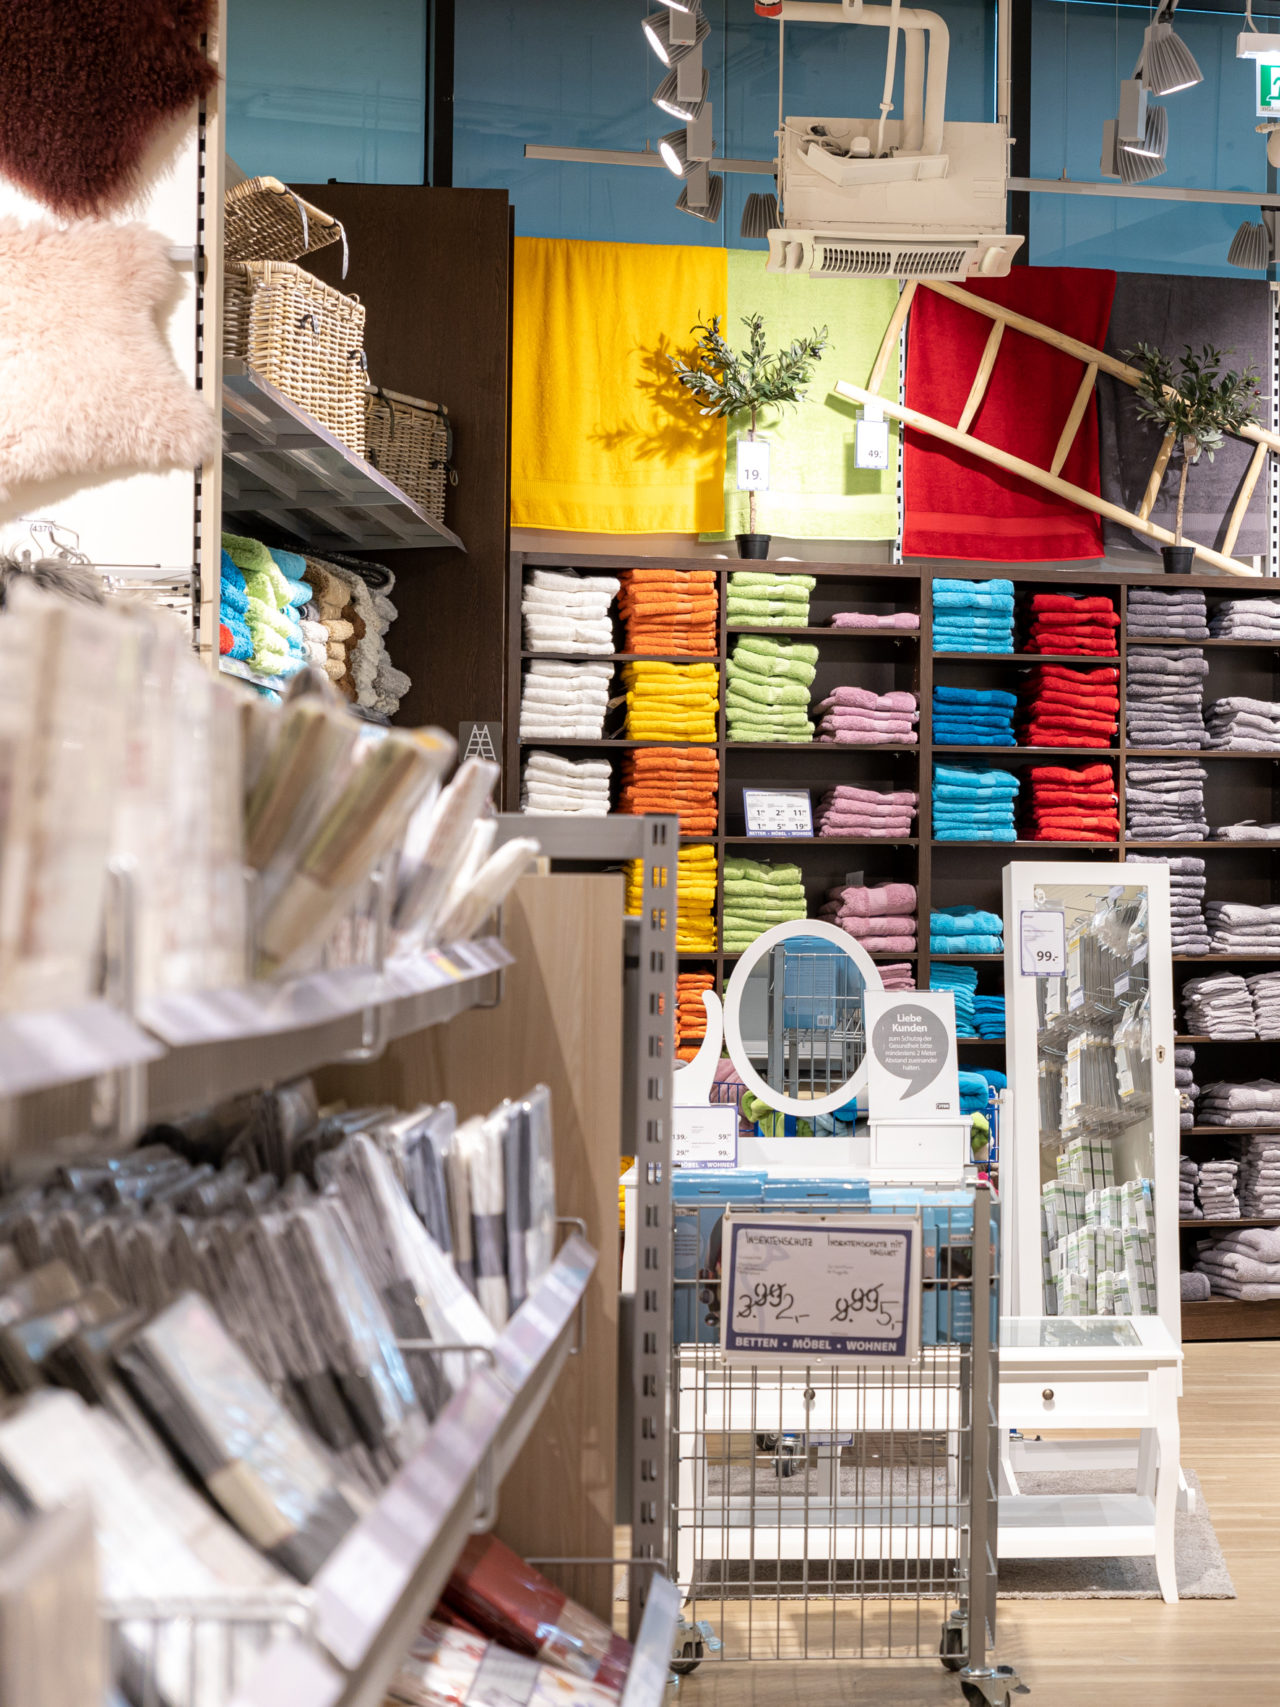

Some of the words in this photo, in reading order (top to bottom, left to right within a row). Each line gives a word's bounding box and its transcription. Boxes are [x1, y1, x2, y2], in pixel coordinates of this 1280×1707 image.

[1036, 950, 1059, 962] 99.-
[896, 1013, 922, 1023] Liebe
[892, 1023, 928, 1033] Kunden
[735, 1337, 778, 1349] BETTEN
[792, 1336, 832, 1350] MÖBEL
[846, 1340, 897, 1352] WOHNEN
